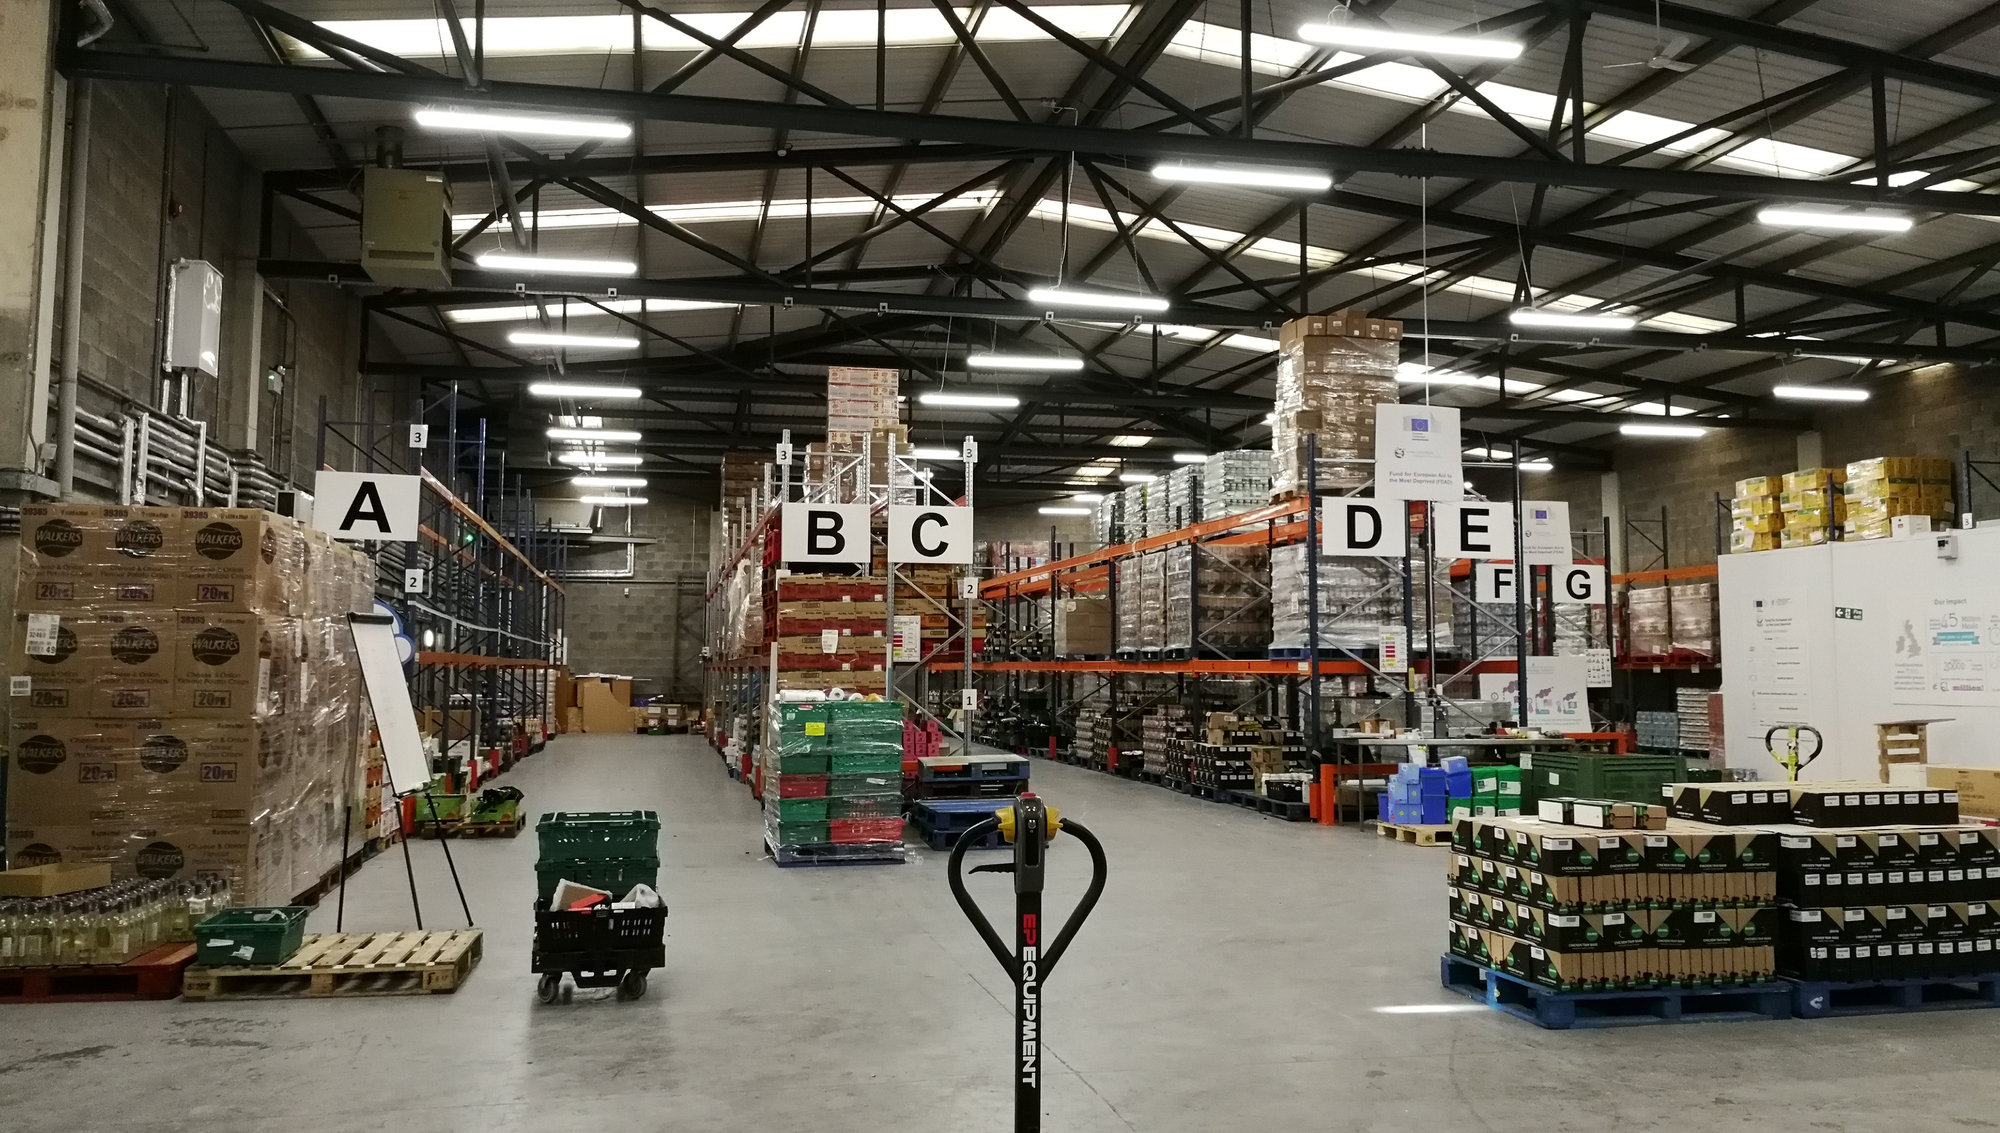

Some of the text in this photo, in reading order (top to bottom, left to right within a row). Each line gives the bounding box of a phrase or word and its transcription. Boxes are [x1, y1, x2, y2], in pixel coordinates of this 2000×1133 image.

[414, 432, 421, 443] 3
[780, 450, 787, 460] 3
[966, 448, 973, 458] 3
[338, 481, 392, 533] A
[184, 511, 208, 519] 39365
[807, 510, 845, 556] B
[1346, 504, 1382, 549] D
[1460, 508, 1491, 552] E
[36, 530, 82, 543] WALKERS
[116, 531, 162, 544] WALKERS
[197, 533, 242, 546] WALKERS
[912, 512, 949, 557] C
[409, 577, 417, 587] 2
[1494, 569, 1512, 599] F
[1566, 569, 1591, 600] G
[40, 585, 69, 598] 20PK
[202, 587, 230, 600] 20PK
[967, 584, 974, 594] 2
[1941, 613, 1958, 629] 45
[112, 638, 158, 649] WALKERS
[193, 639, 239, 650] WALKERS
[117, 692, 146, 706] 20PK
[199, 692, 226, 706] 20PK
[966, 696, 972, 705] 1
[20, 747, 65, 759] WALKERS
[203, 766, 234, 780] 20PK
[139, 854, 182, 865] WALKERS
[1023, 914, 1036, 1088] EP EQUIPMENT
